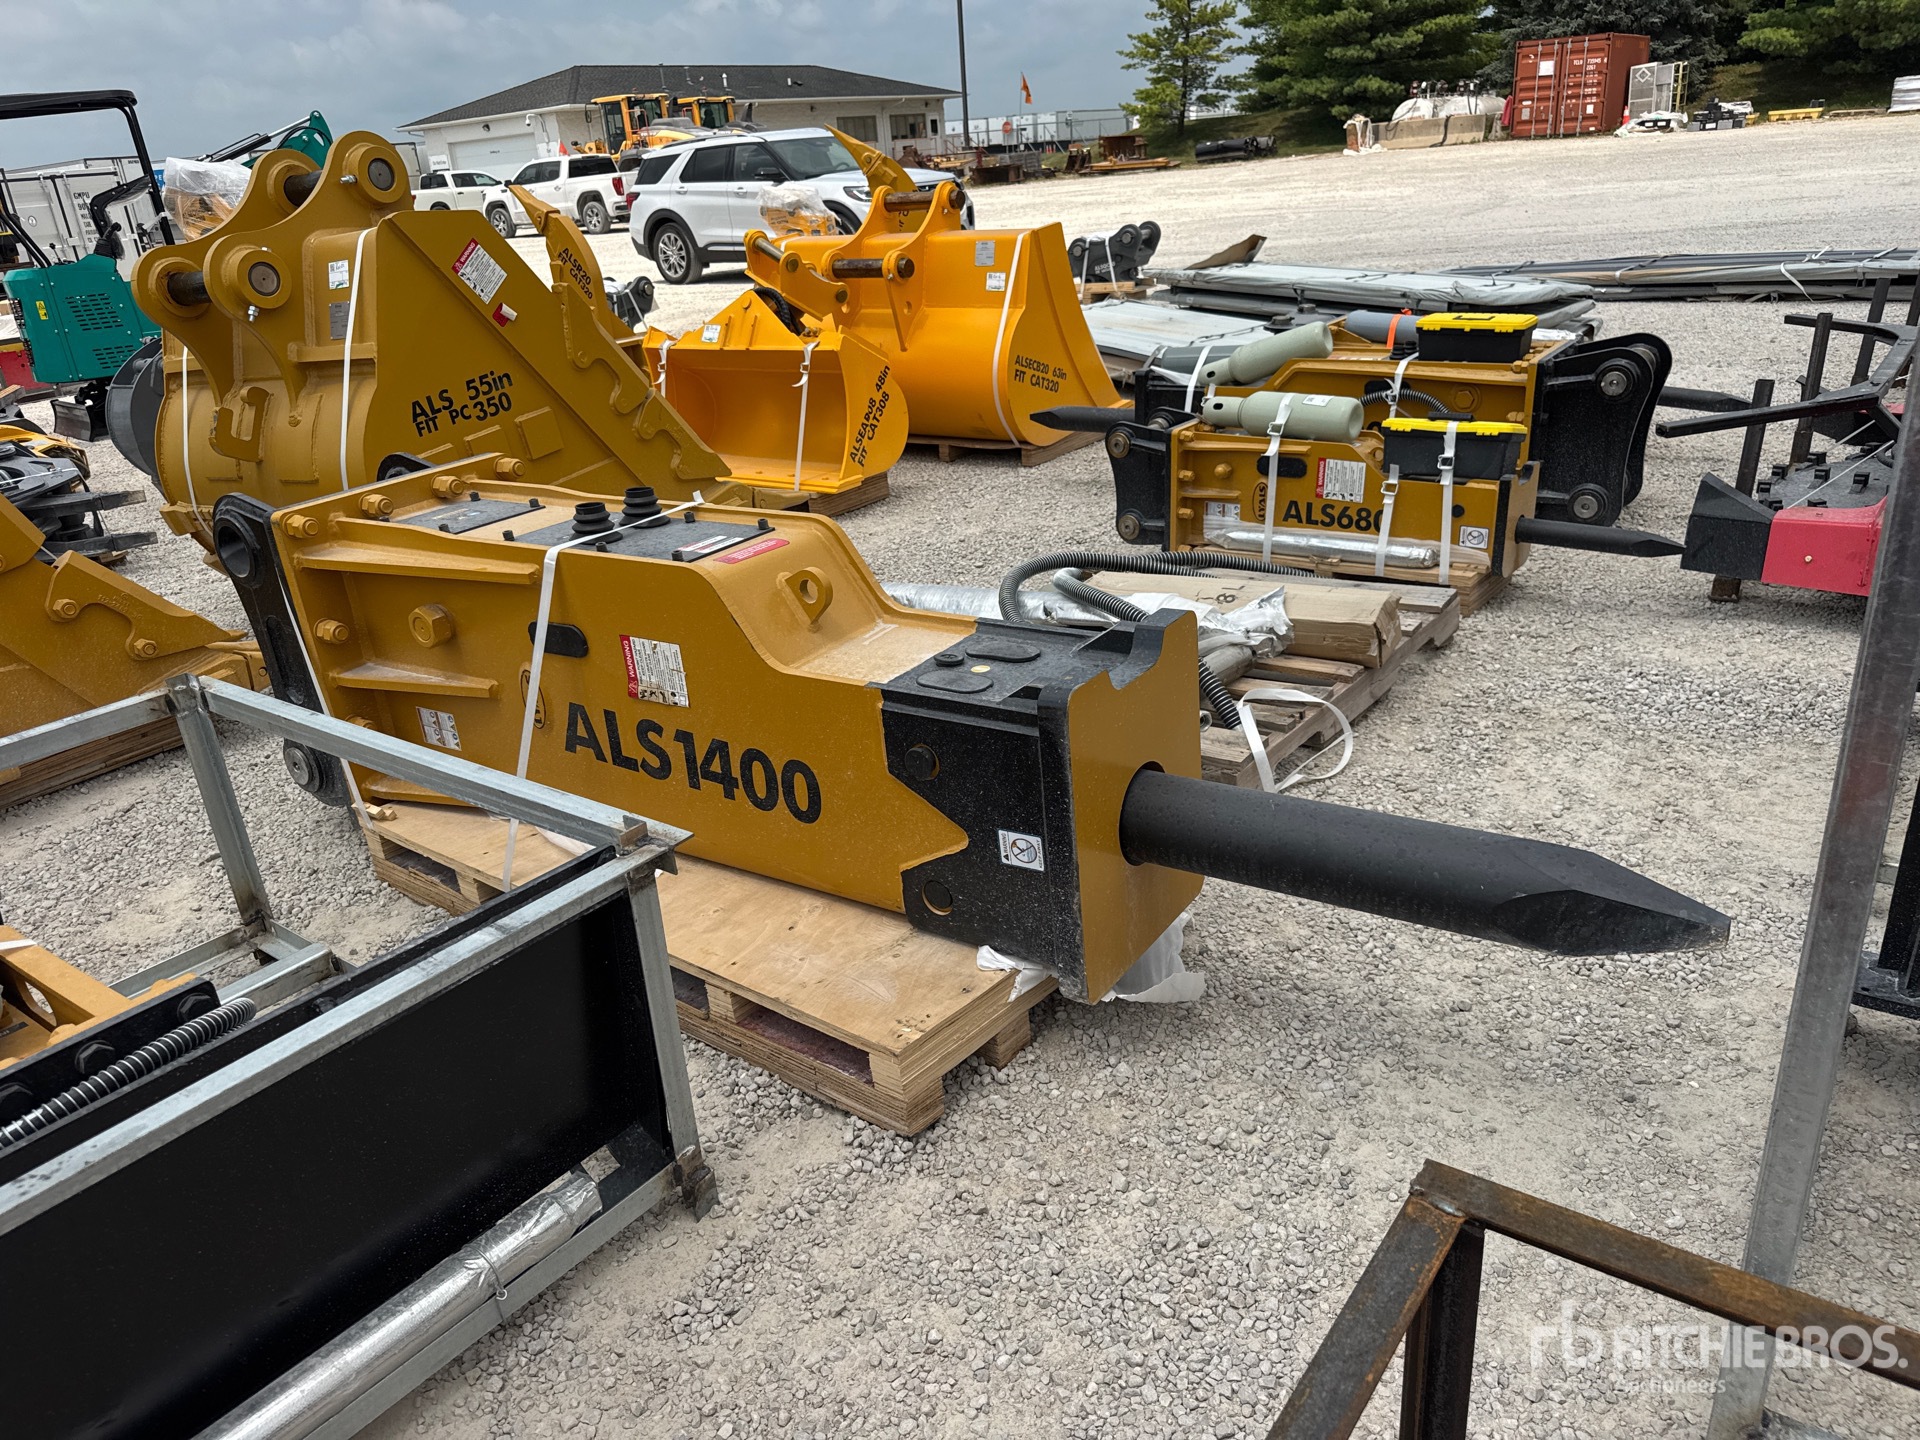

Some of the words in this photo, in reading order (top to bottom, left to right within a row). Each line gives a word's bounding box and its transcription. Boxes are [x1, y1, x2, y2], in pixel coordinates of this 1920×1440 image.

[558, 251, 568, 266] FIT
[569, 267, 593, 300] CAT320
[563, 247, 592, 286] ALSR20
[875, 364, 890, 393] 48in
[1014, 354, 1050, 375] ALSECB20
[1014, 368, 1027, 384] FIT
[1030, 373, 1060, 393] CAT320
[411, 388, 454, 424] ALS
[465, 370, 513, 401] 55in
[414, 415, 439, 438] FIT
[448, 403, 472, 425] PC
[472, 391, 512, 422] 350
[857, 446, 868, 468] FIT
[867, 391, 890, 441] CAT308
[622, 640, 636, 678] WARNING
[564, 702, 822, 824] ALS1400
[1001, 832, 1009, 854] WARNING
